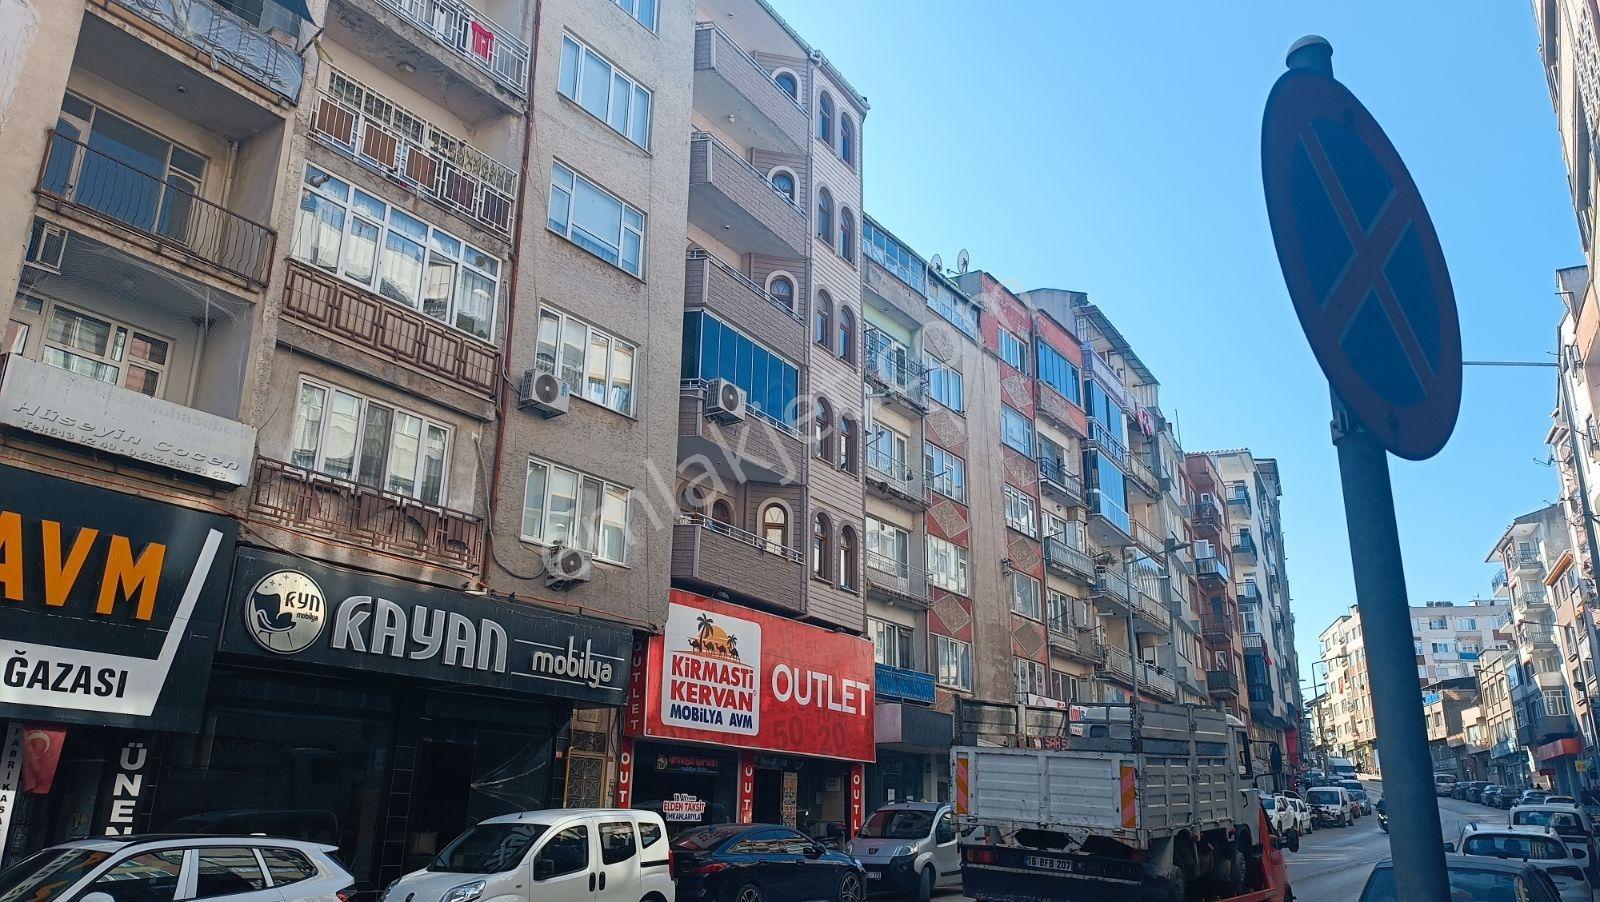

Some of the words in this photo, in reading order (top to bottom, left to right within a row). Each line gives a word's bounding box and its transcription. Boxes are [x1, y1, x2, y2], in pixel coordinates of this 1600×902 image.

[13, 401, 142, 446] Hüseyin
[331, 595, 509, 674] KAYAN
[531, 635, 614, 689] mobilya
[630, 640, 644, 730] OUTLET
[670, 678, 753, 713] KERVAN
[771, 663, 870, 717] OUTLET
[728, 712, 753, 729] AVM
[664, 801, 684, 812] ELDEN
